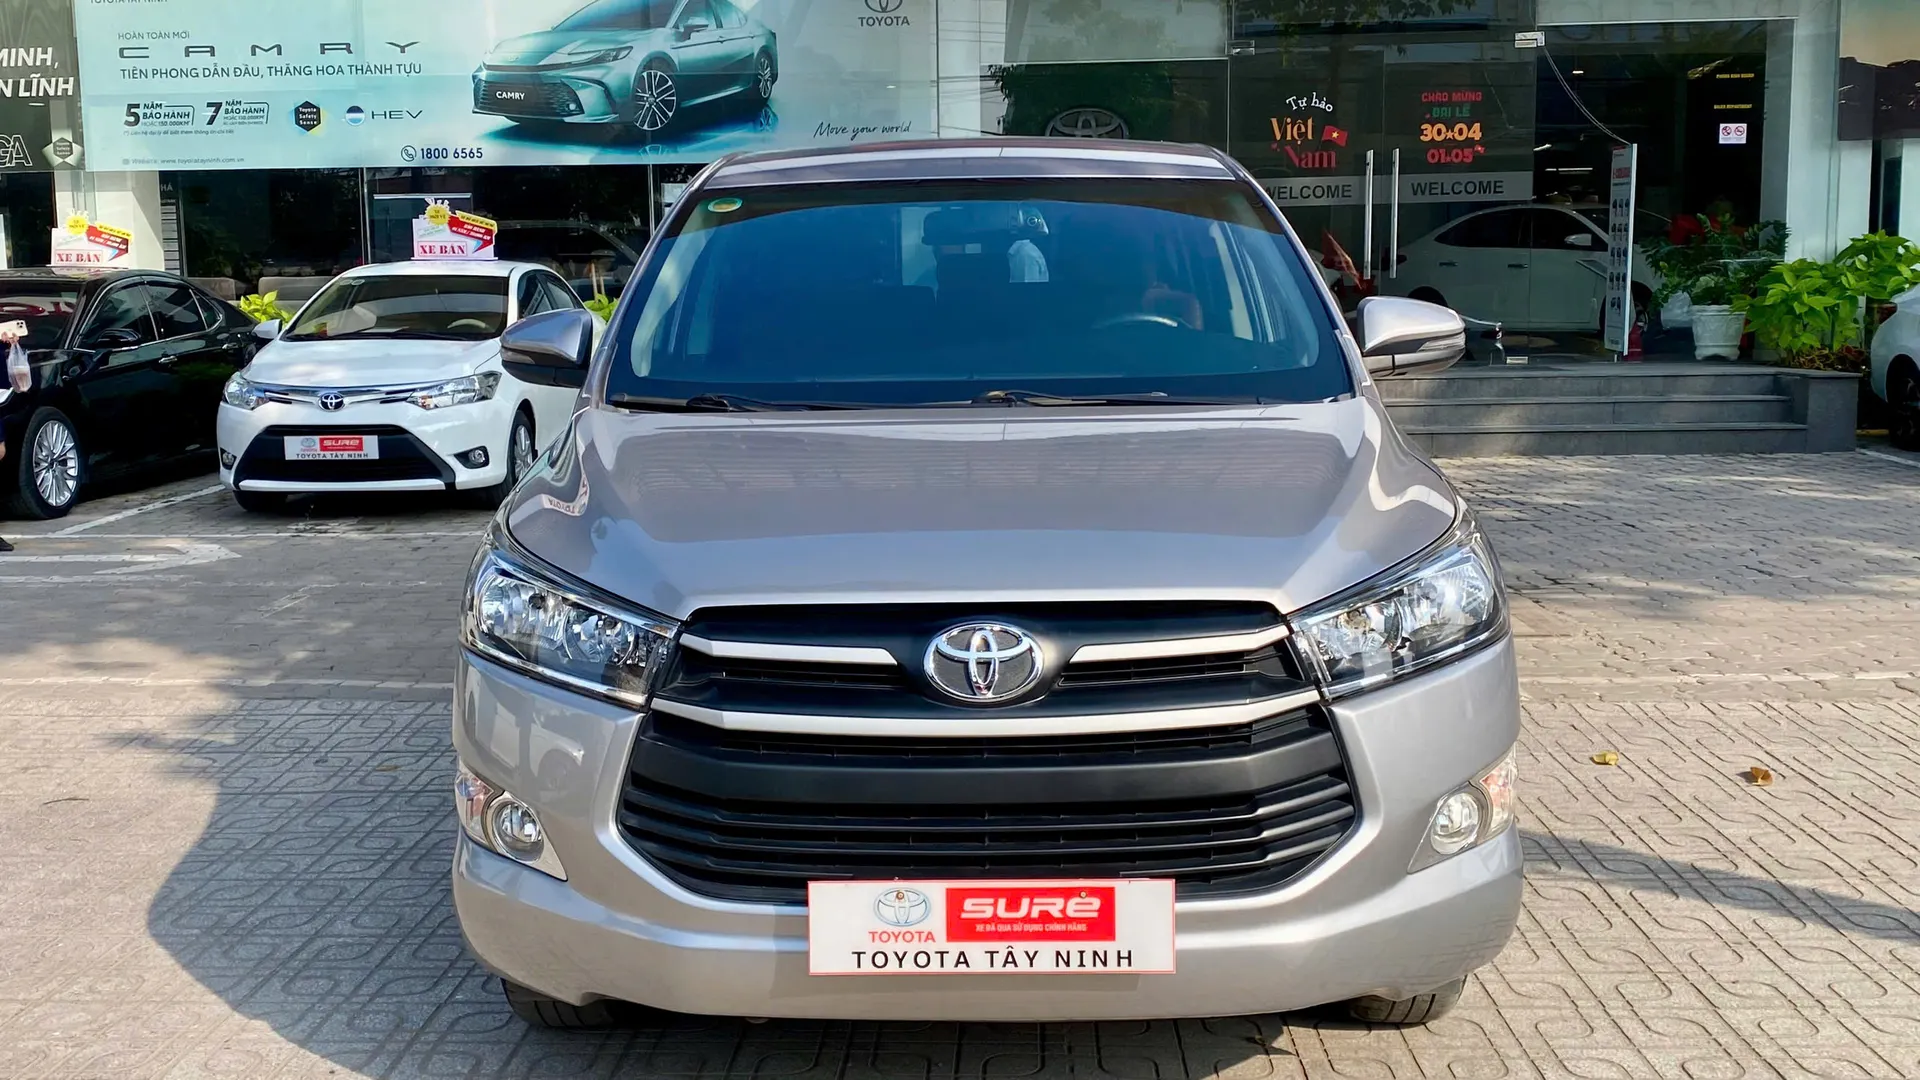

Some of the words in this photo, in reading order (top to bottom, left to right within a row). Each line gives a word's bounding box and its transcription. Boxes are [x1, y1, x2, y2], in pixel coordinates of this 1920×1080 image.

[858, 16, 911, 27] TOYOTA
[118, 31, 145, 40] HOÀN
[147, 31, 171, 39] TOÀN
[119, 41, 420, 58] CAMRY
[120, 66, 149, 79] TIÊN
[152, 68, 200, 79] PHONG
[203, 63, 230, 78] DẪN
[233, 63, 264, 79] ĐẦU,
[316, 65, 345, 76] HOA
[347, 62, 393, 75] THÀNH
[396, 62, 422, 77] TỰU
[19, 73, 74, 97] LĨNH
[496, 91, 525, 100] CAMRY
[1286, 95, 1307, 111] Tự
[1311, 92, 1333, 112] hào
[124, 103, 141, 127] 5
[163, 110, 191, 120] HÀNH
[206, 102, 223, 126] 7
[242, 106, 265, 115] HÀNH
[371, 110, 423, 119] HEV
[813, 121, 849, 139] Move
[850, 125, 878, 141] your
[881, 120, 912, 134] world
[1270, 116, 1313, 145] Việt
[420, 148, 448, 159] 1800
[453, 147, 483, 159] 6565
[1284, 145, 1337, 168] Nam
[1411, 180, 1504, 196] WELCOME
[420, 245, 436, 254] XE
[440, 243, 466, 254] BÁN
[56, 253, 73, 262] XE
[76, 252, 101, 263] BÁN
[868, 931, 936, 944] TOYOTA
[851, 951, 971, 969] TOYOTA
[984, 945, 1039, 969] TÂY
[1054, 949, 1134, 969] NINH
